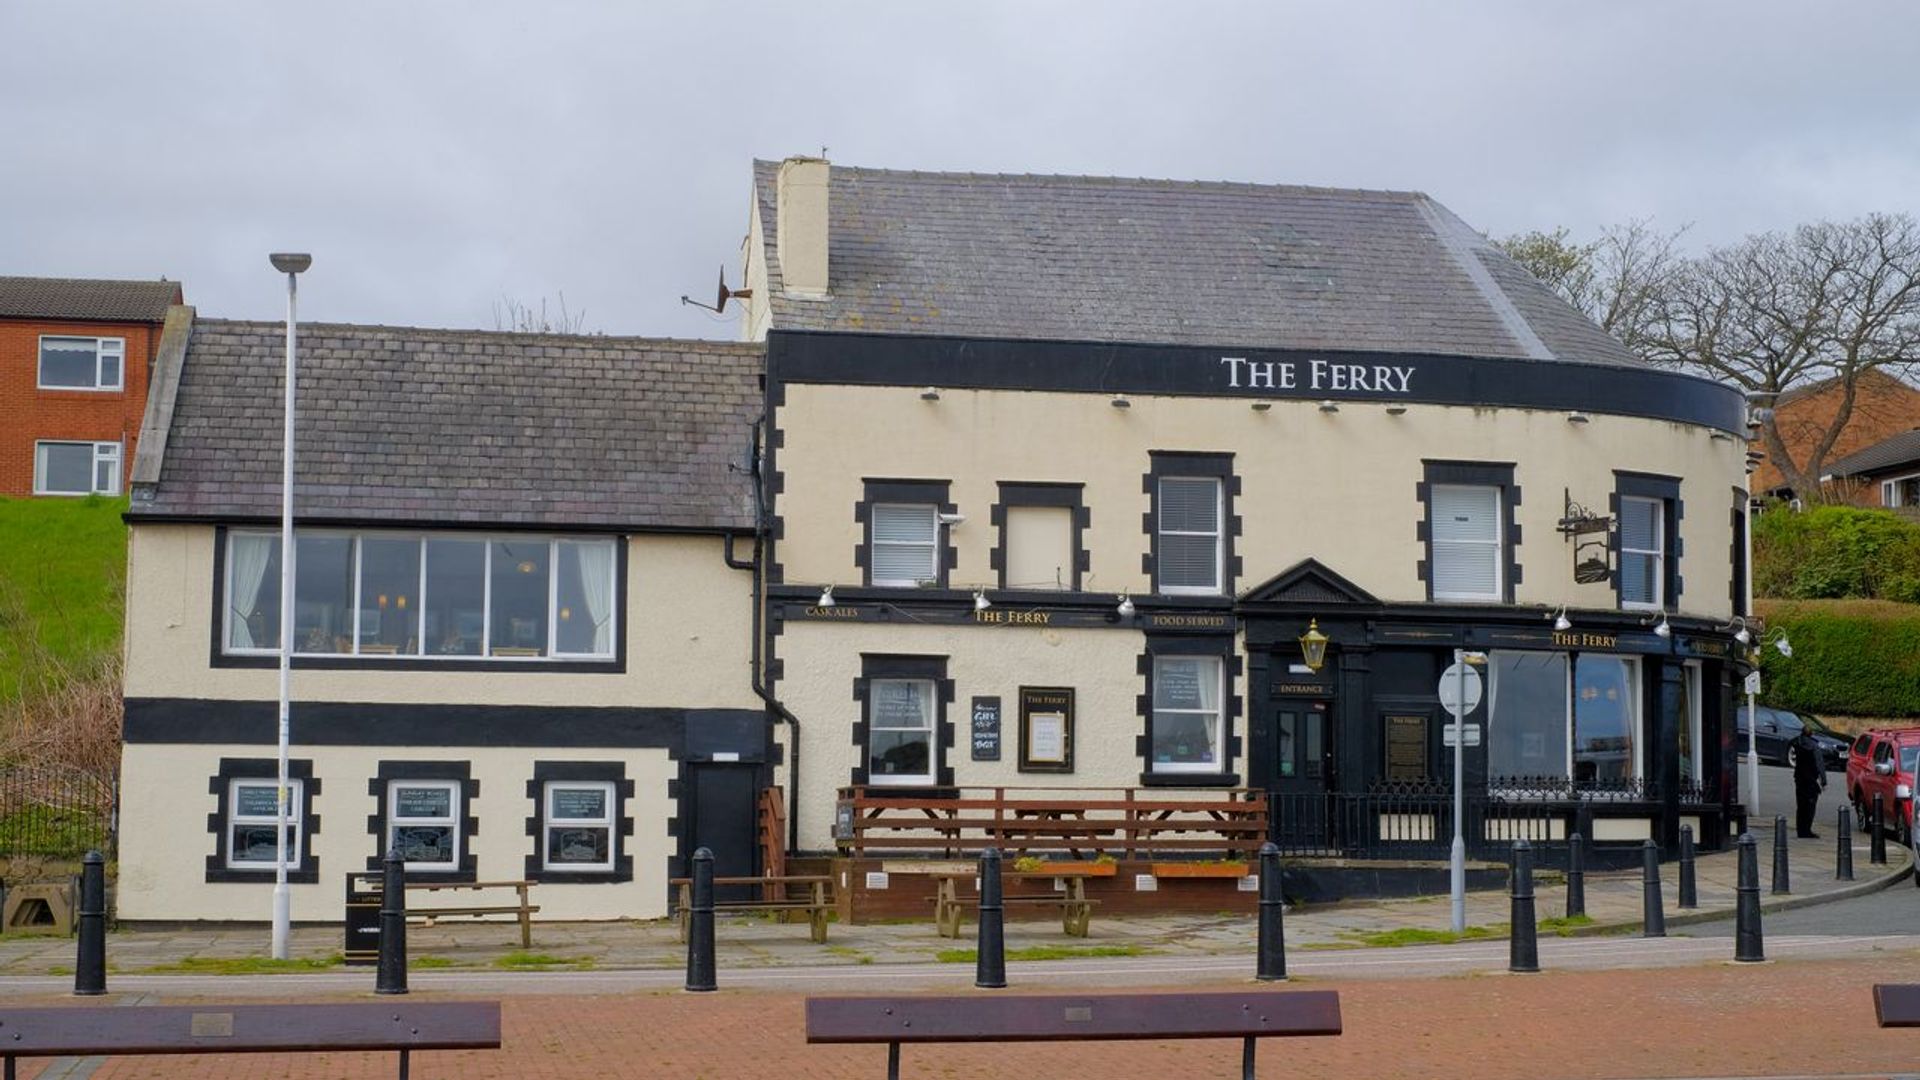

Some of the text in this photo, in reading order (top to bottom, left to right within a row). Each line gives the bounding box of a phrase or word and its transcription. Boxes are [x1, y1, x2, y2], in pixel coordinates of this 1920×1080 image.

[1220, 357, 1416, 392] THE FERRY
[805, 607, 859, 617] CASK ALES
[975, 610, 1050, 624] THE FERRY
[1153, 616, 1225, 626] FOOD SERVED
[1553, 632, 1617, 647] THE FERRY
[1280, 684, 1323, 694] ENTRANCE
[1027, 696, 1066, 704] THE FERRY
